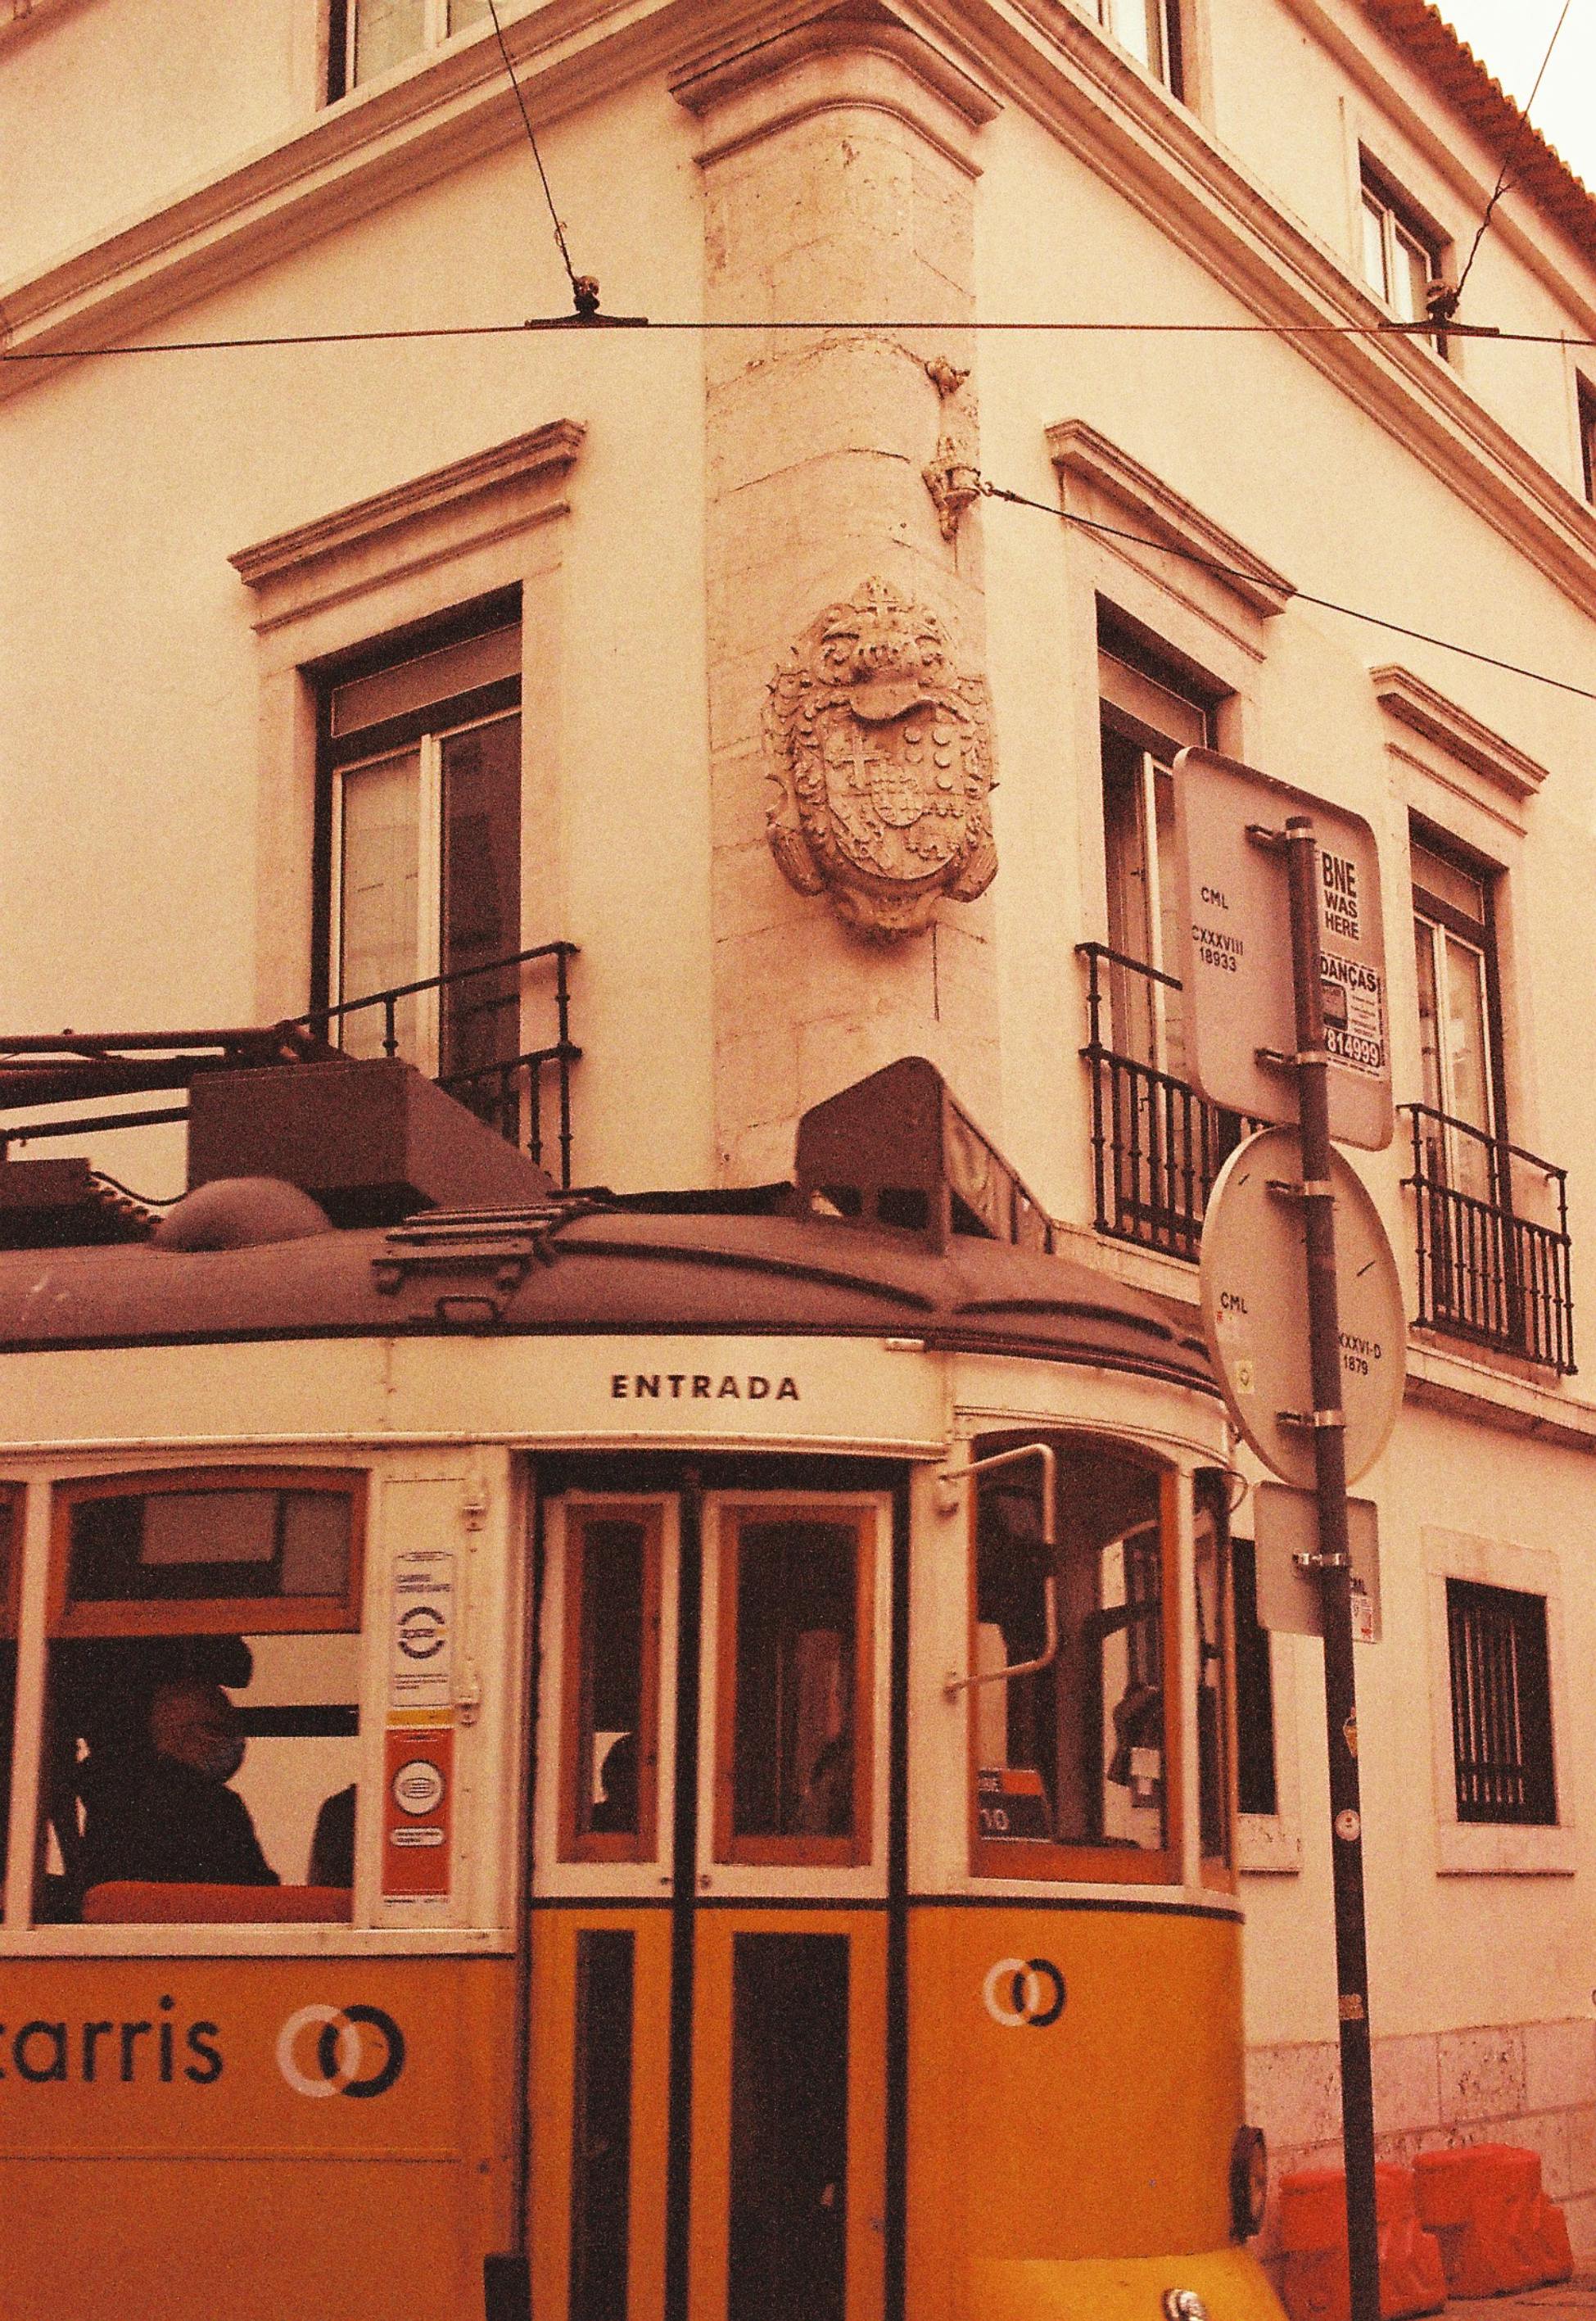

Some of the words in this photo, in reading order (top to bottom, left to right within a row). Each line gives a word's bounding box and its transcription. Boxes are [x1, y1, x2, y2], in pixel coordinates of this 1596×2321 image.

[1322, 851, 1357, 898] BNE
[1200, 887, 1228, 910] CML
[1324, 889, 1359, 919] WAS
[1192, 925, 1244, 956] CXXXVIII
[1325, 911, 1359, 941] HERE
[1200, 946, 1237, 972] 18933
[1320, 955, 1377, 993] DANÇAS
[1322, 1027, 1380, 1067] 814999
[1220, 1292, 1248, 1314] CML
[1344, 1354, 1368, 1376] 1879
[612, 1374, 800, 1400] ENTRADA
[0, 1994, 224, 2084] arris
